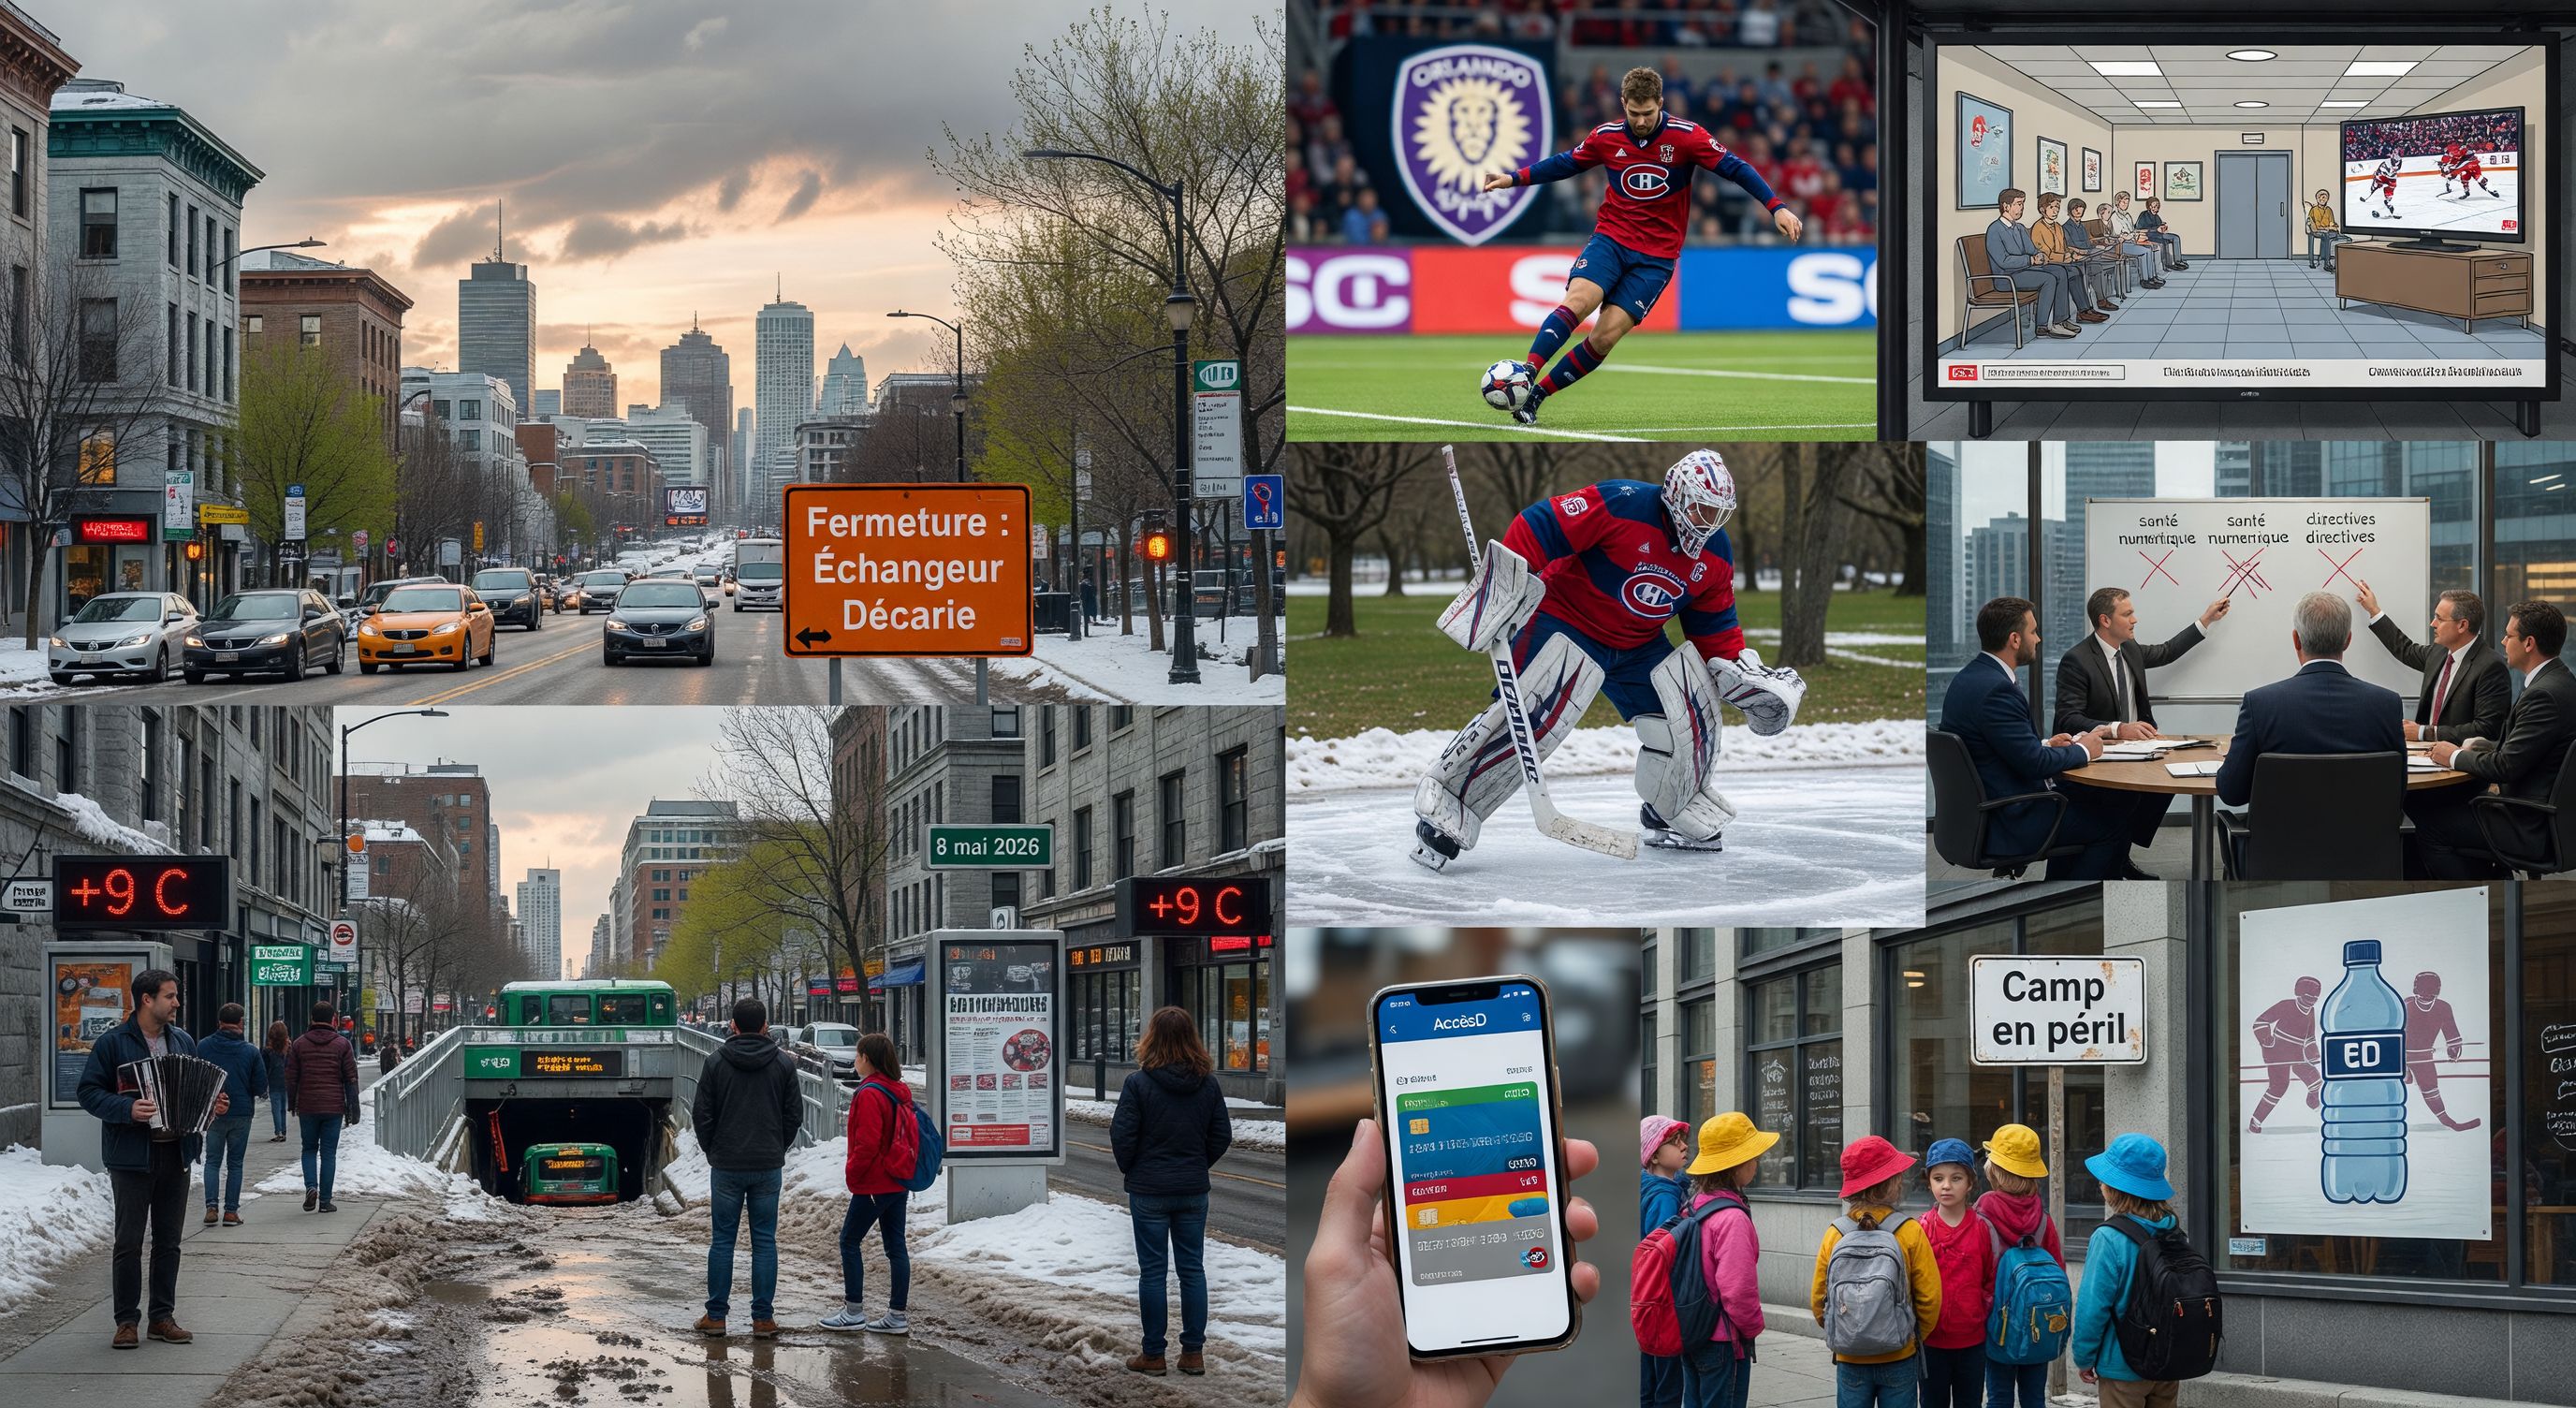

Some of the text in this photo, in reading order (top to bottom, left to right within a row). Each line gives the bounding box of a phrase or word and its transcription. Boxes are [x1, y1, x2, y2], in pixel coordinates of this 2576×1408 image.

[1786, 252, 1878, 325] S
[807, 506, 1009, 538] Fermeture :
[2139, 513, 2179, 527] santé
[2227, 512, 2266, 527] santé
[2305, 511, 2377, 526] directives
[2305, 529, 2377, 544] directives
[813, 545, 1005, 592] Échangeur
[842, 597, 977, 631] Décarie
[936, 836, 1040, 856] 8 mai 2026
[70, 868, 136, 916] +9
[154, 868, 189, 916] C
[1149, 886, 1243, 925] +9 C
[2002, 970, 2105, 1010] Camp
[1433, 1012, 1487, 1031] AccèsD
[1992, 1011, 2127, 1053] en péril
[2344, 1040, 2380, 1068] ED
